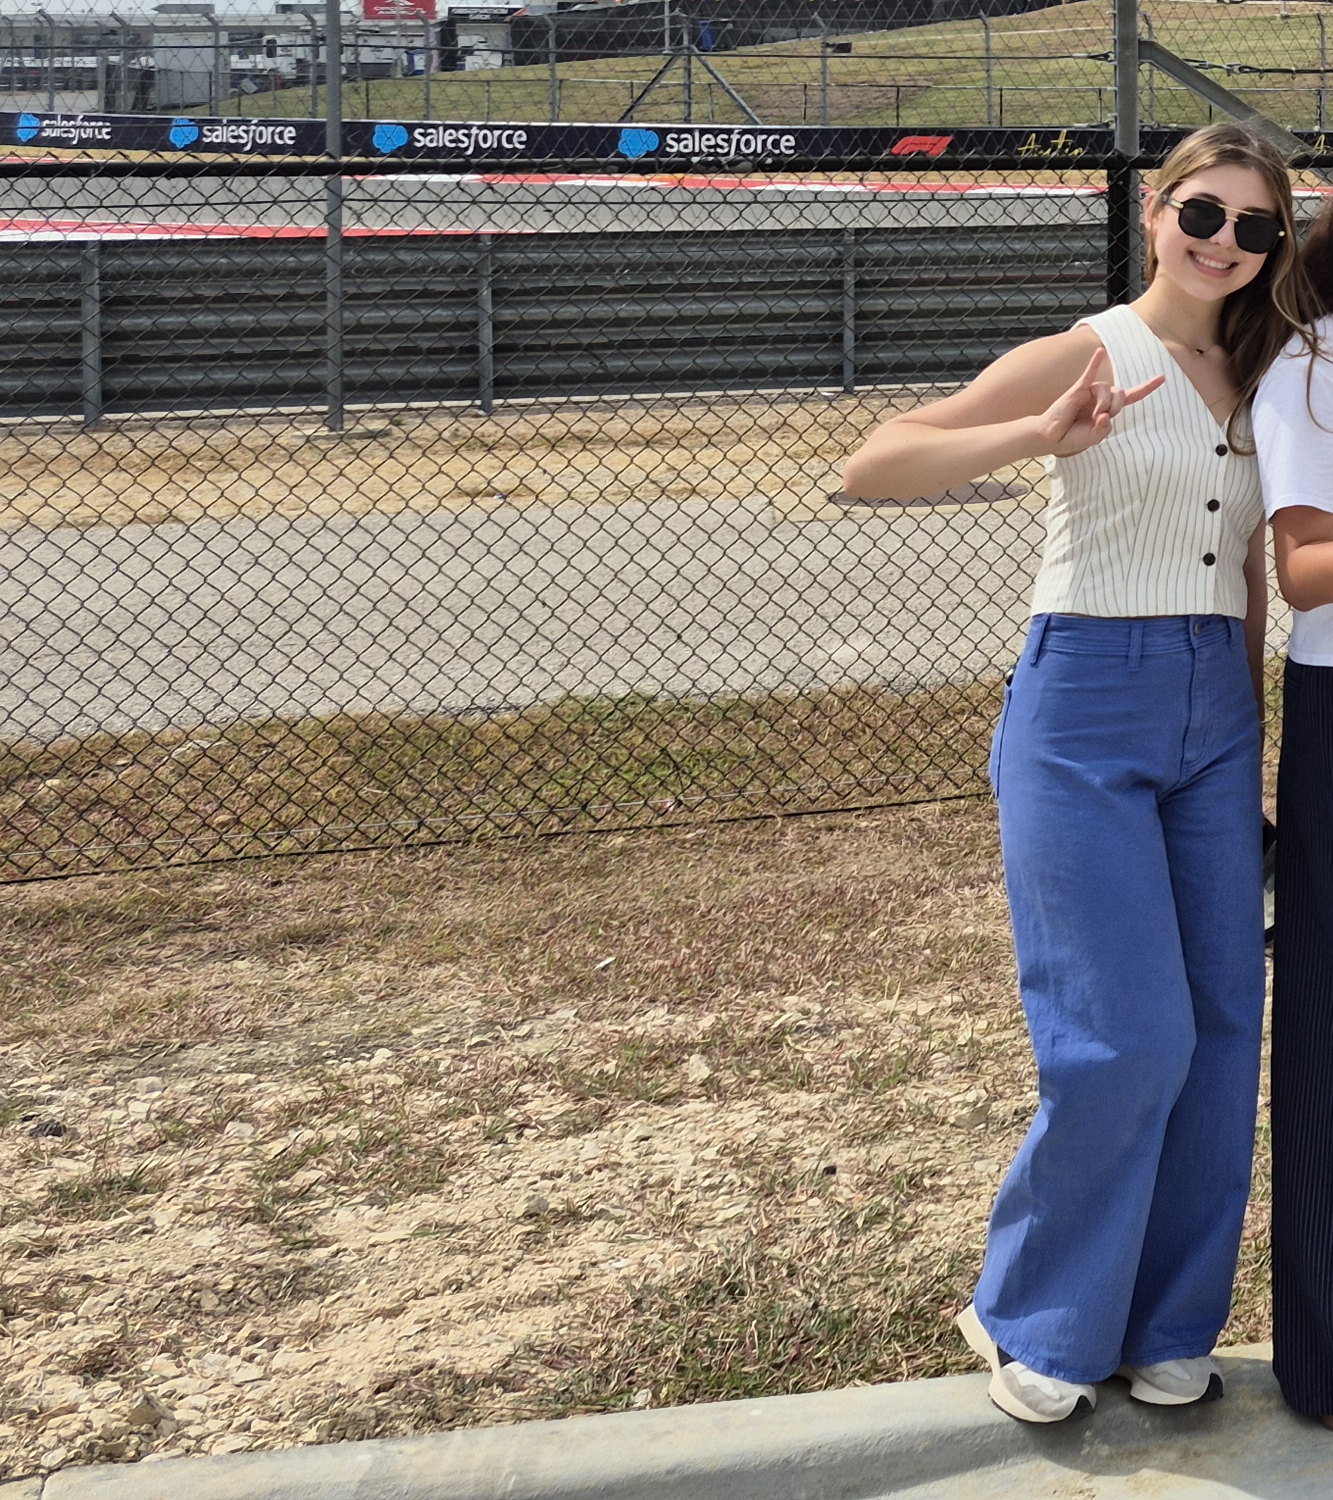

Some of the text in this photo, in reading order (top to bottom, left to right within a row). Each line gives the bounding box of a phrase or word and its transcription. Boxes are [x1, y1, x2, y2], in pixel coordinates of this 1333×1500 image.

[40, 115, 112, 145] salesforce
[201, 119, 297, 152] salesforce
[413, 126, 528, 155] salesforce
[665, 128, 796, 157] salesforce
